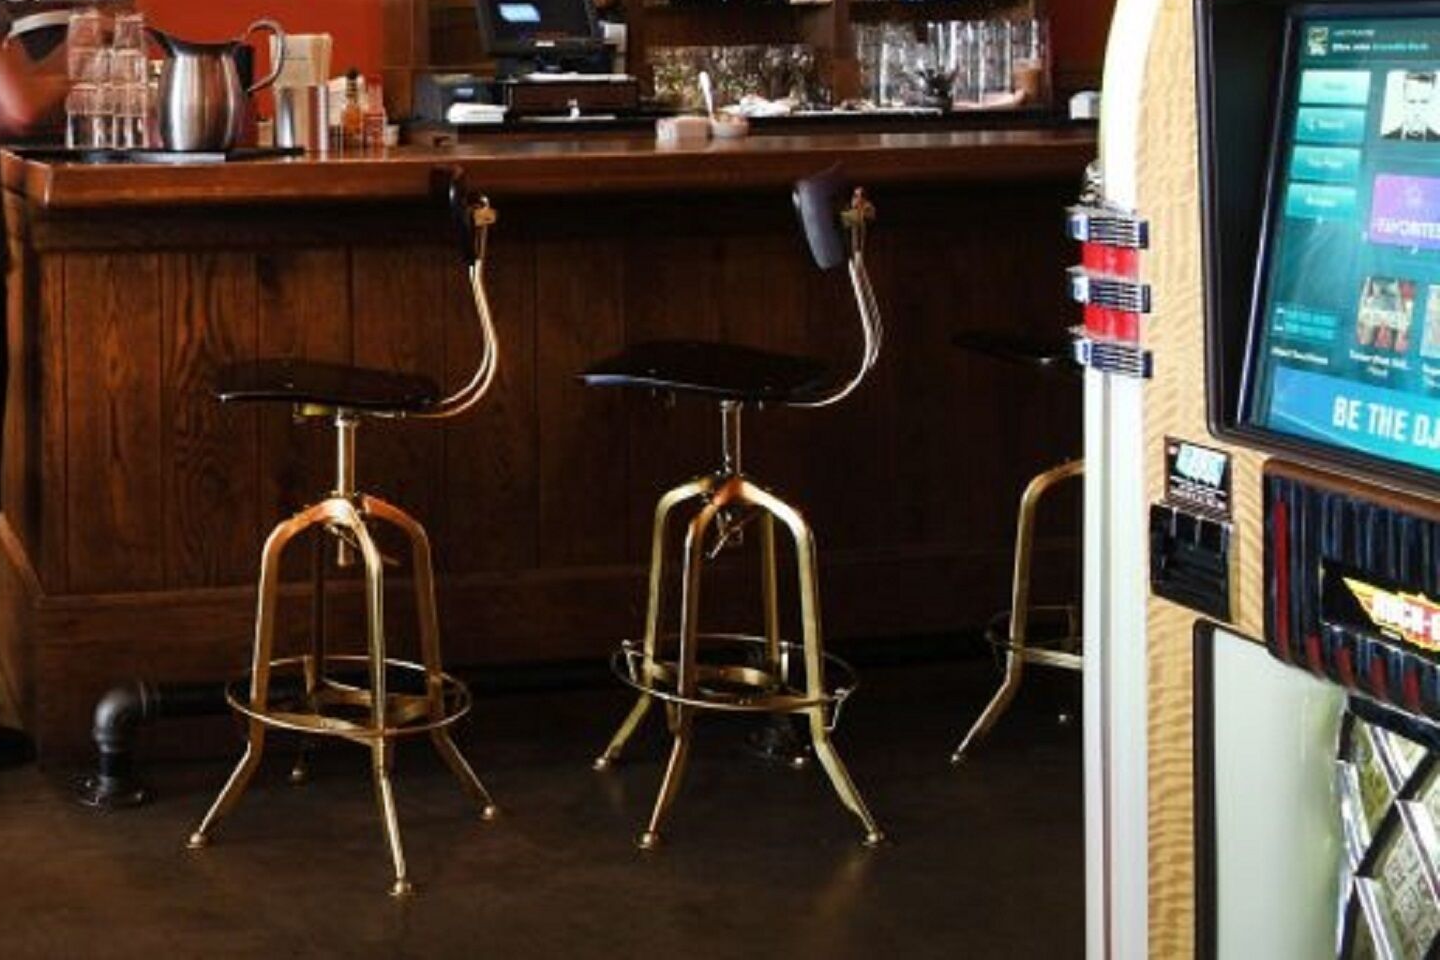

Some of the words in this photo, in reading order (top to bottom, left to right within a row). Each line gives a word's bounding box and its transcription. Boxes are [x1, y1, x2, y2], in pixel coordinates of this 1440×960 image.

[1374, 217, 1440, 238] FAVORITE
[1332, 394, 1362, 432] BE
[1367, 402, 1409, 441] THE
